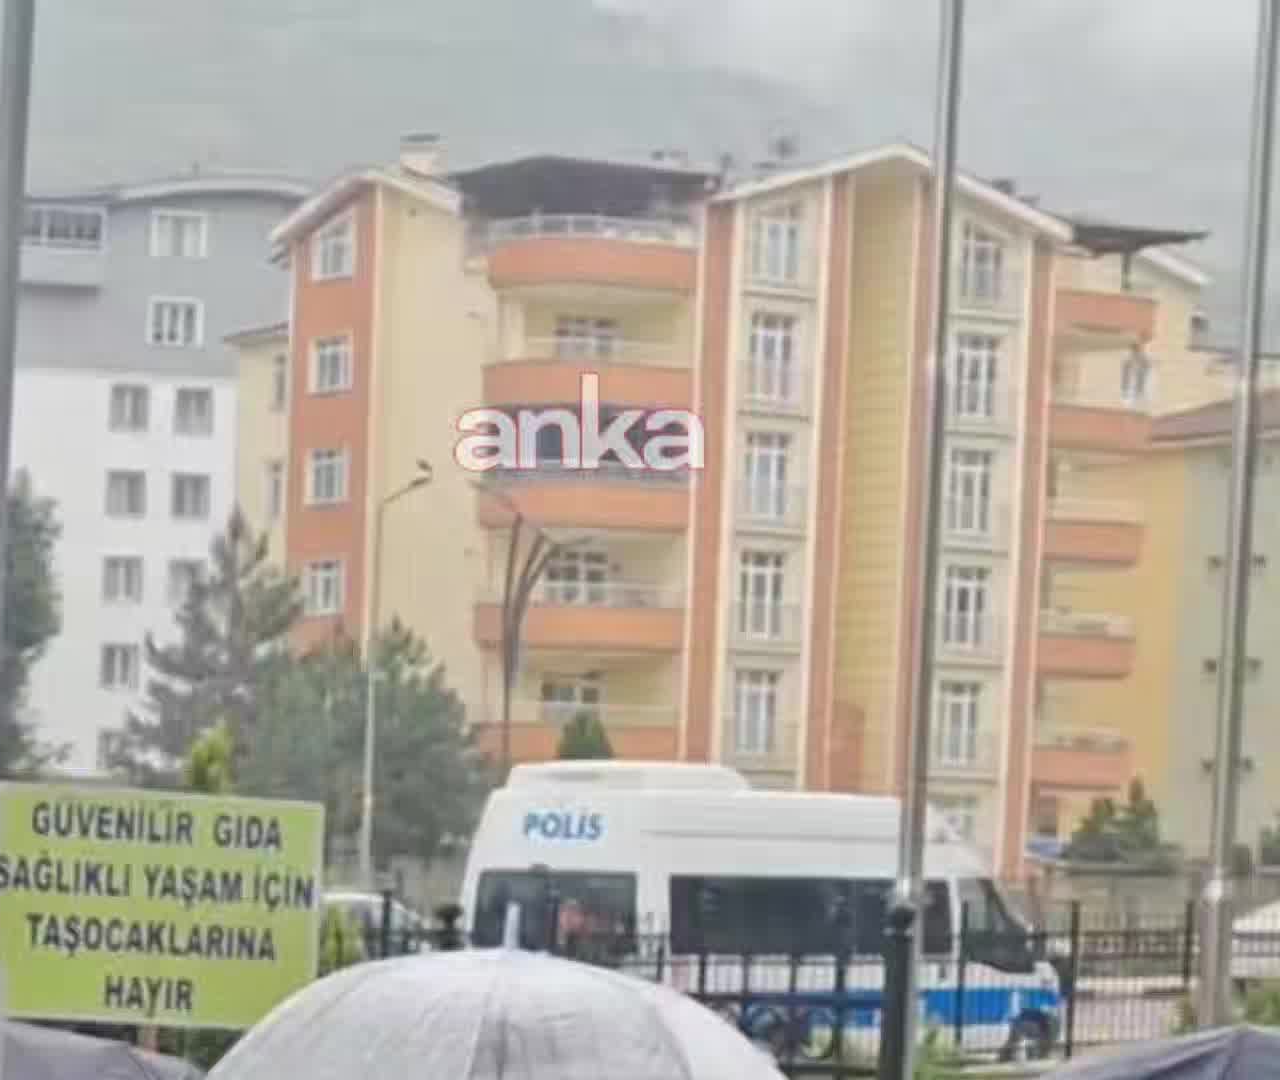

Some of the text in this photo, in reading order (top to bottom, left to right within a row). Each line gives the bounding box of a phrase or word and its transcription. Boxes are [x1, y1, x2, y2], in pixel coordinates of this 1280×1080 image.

[212, 815, 282, 850] GIDA
[143, 864, 244, 911] YAŞAM
[253, 866, 315, 913] İÇİN
[26, 912, 276, 961] TAŞOCAKLARINA
[104, 975, 194, 1011] HAYIR
